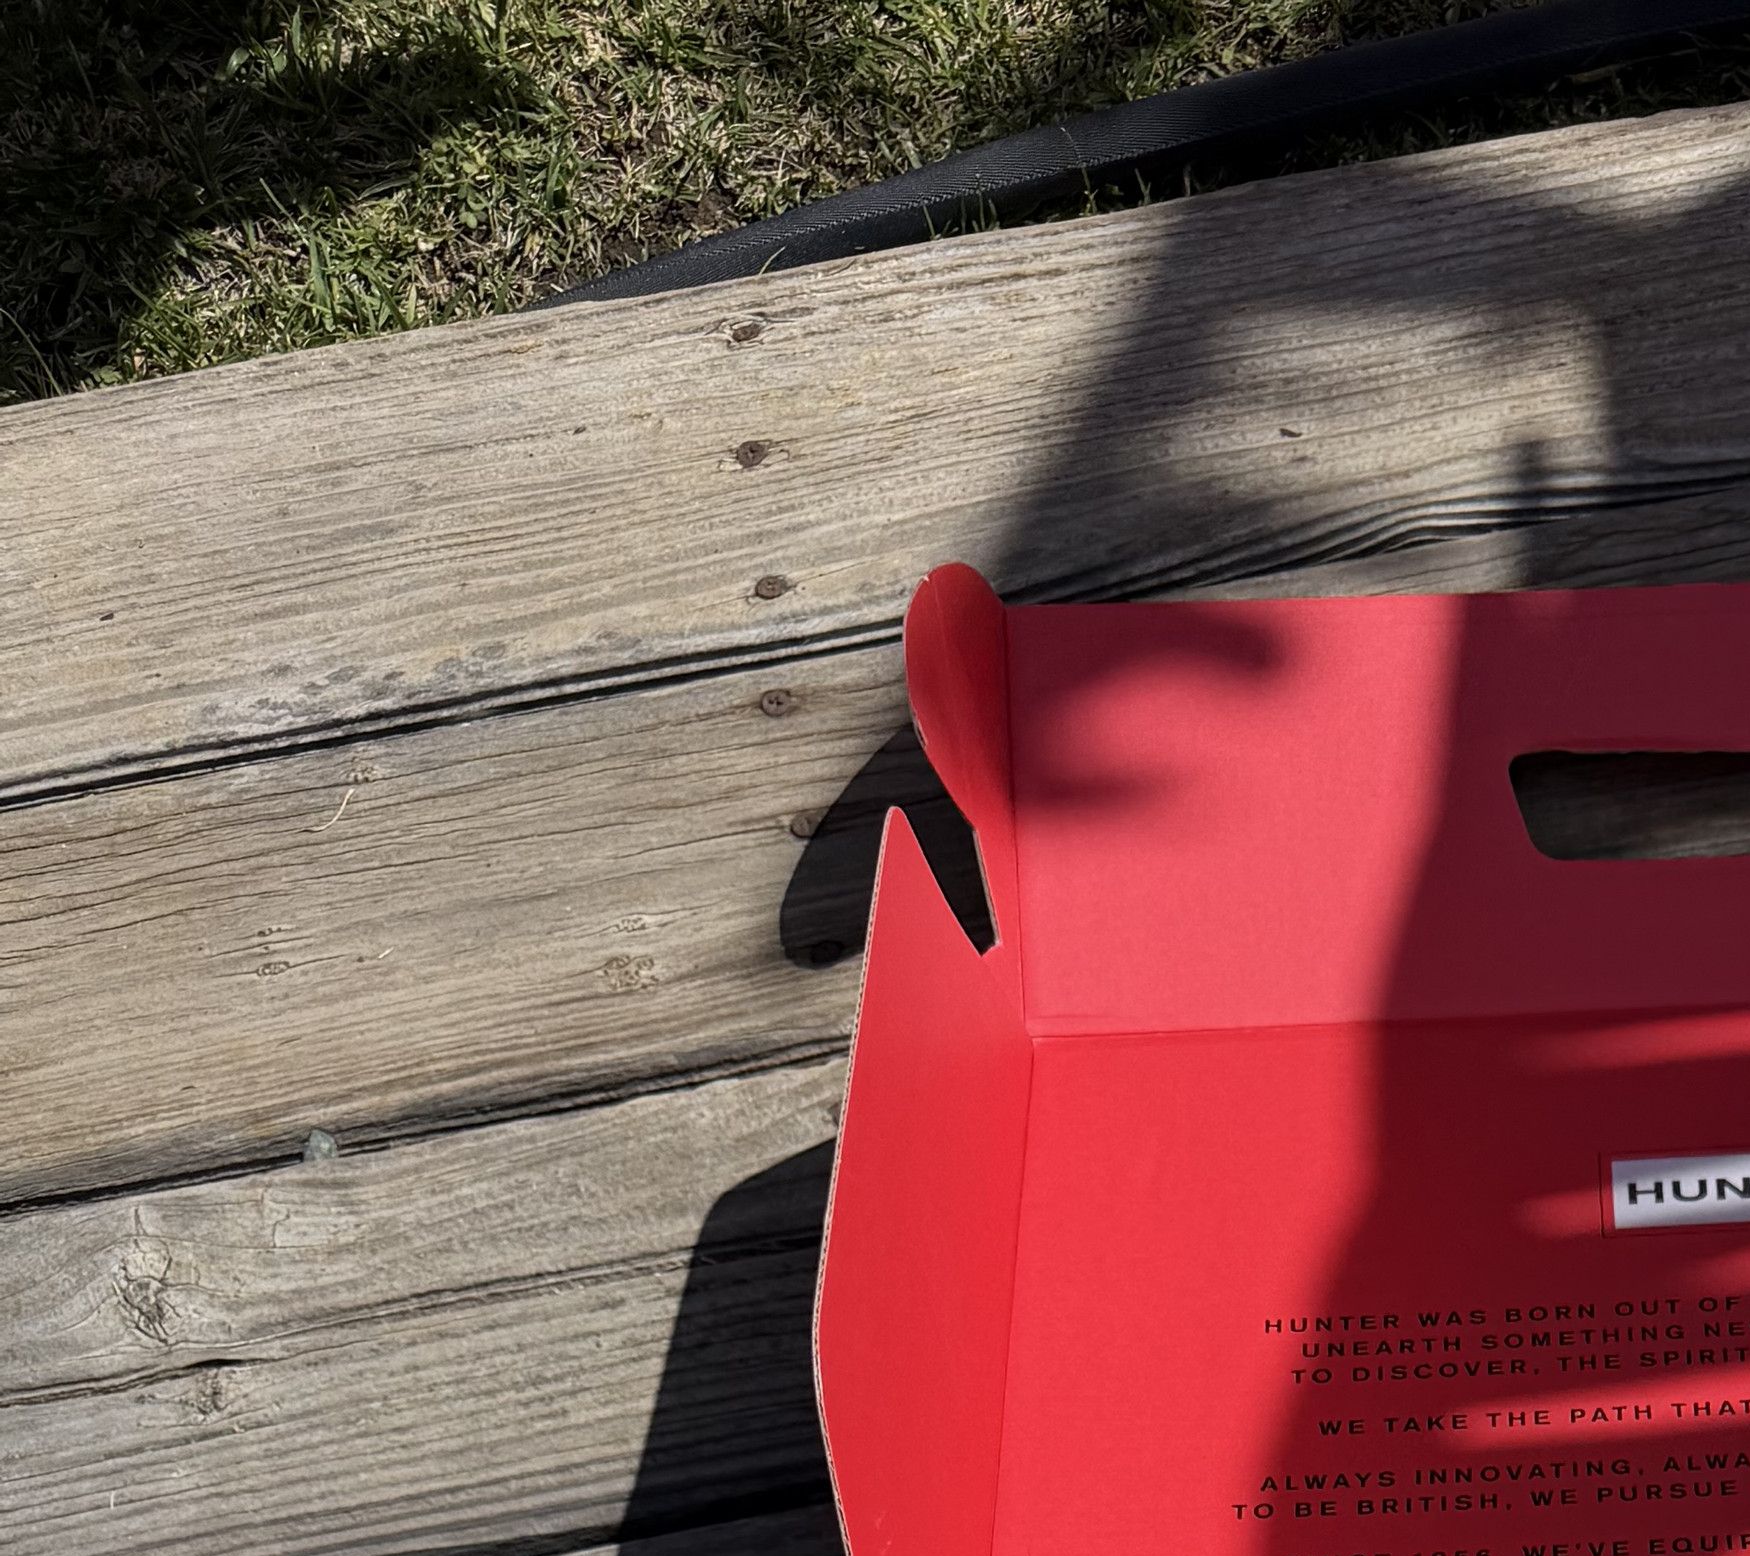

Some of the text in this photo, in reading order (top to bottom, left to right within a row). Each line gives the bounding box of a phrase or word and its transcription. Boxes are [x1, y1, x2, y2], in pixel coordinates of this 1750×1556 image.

[1265, 1315, 1399, 1334] HUNTER
[1418, 1311, 1486, 1328] WAS
[1505, 1305, 1595, 1323] BORN
[1615, 1300, 1678, 1316] OUT
[1699, 1297, 1738, 1313] OF
[1302, 1337, 1461, 1358] UNEARTH
[1482, 1325, 1684, 1350] SOMETHING
[1292, 1369, 1333, 1384] TO
[1352, 1360, 1538, 1382] DISCOVER,
[1559, 1355, 1618, 1372] THE
[1640, 1348, 1746, 1367] SPIRIT
[1319, 1420, 1363, 1436] WE
[1386, 1415, 1466, 1433] TAKE
[1487, 1411, 1550, 1428] THE
[1571, 1406, 1652, 1424] PATH
[1260, 1471, 1395, 1492] ALWAYS
[1416, 1460, 1643, 1485] INNOVATING,
[1232, 1504, 1274, 1520] TO
[1295, 1501, 1336, 1518] BE
[1357, 1494, 1511, 1516] BRITISH,
[1531, 1490, 1575, 1507] WE
[1597, 1481, 1735, 1503] PURSUE
